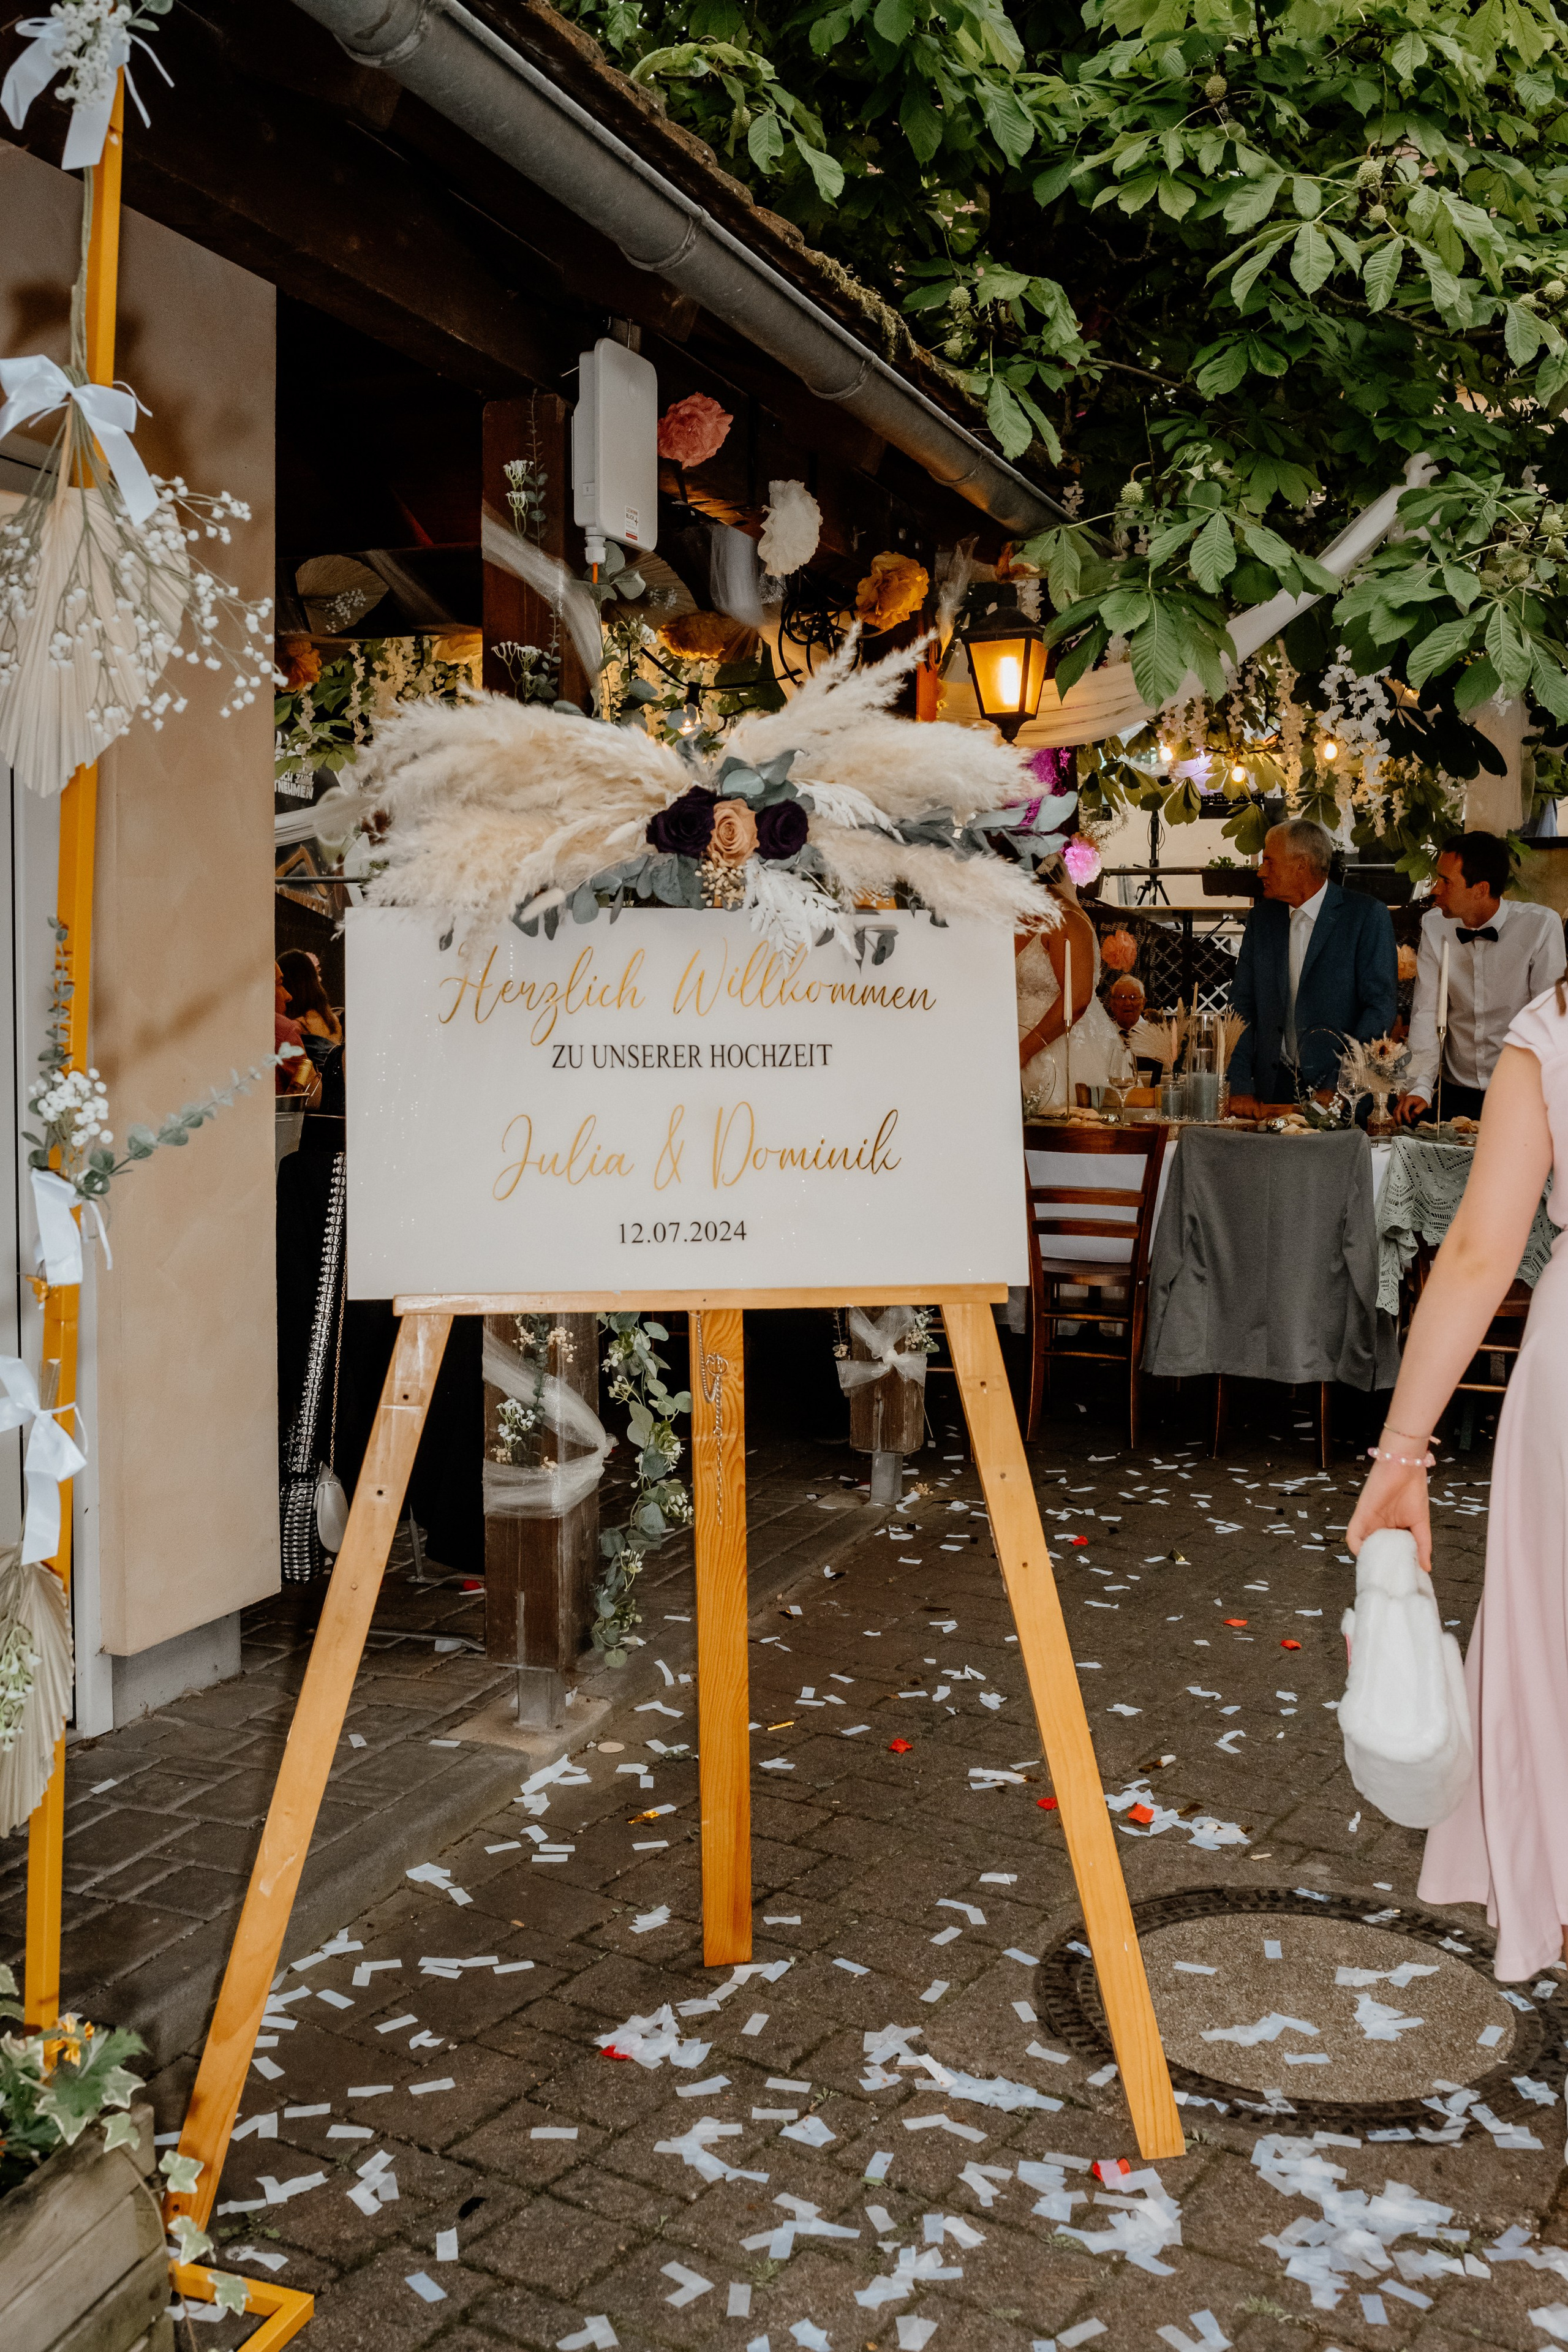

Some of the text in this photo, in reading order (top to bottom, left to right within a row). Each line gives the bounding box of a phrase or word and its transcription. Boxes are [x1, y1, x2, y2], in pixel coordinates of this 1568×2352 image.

[438, 937, 937, 1046] Herzlich Willkommen
[552, 1043, 833, 1069] ZU UNSERER HOCHZEIT
[492, 1101, 902, 1201] Julia & Dominik
[618, 1220, 747, 1244] 12.07.2024
